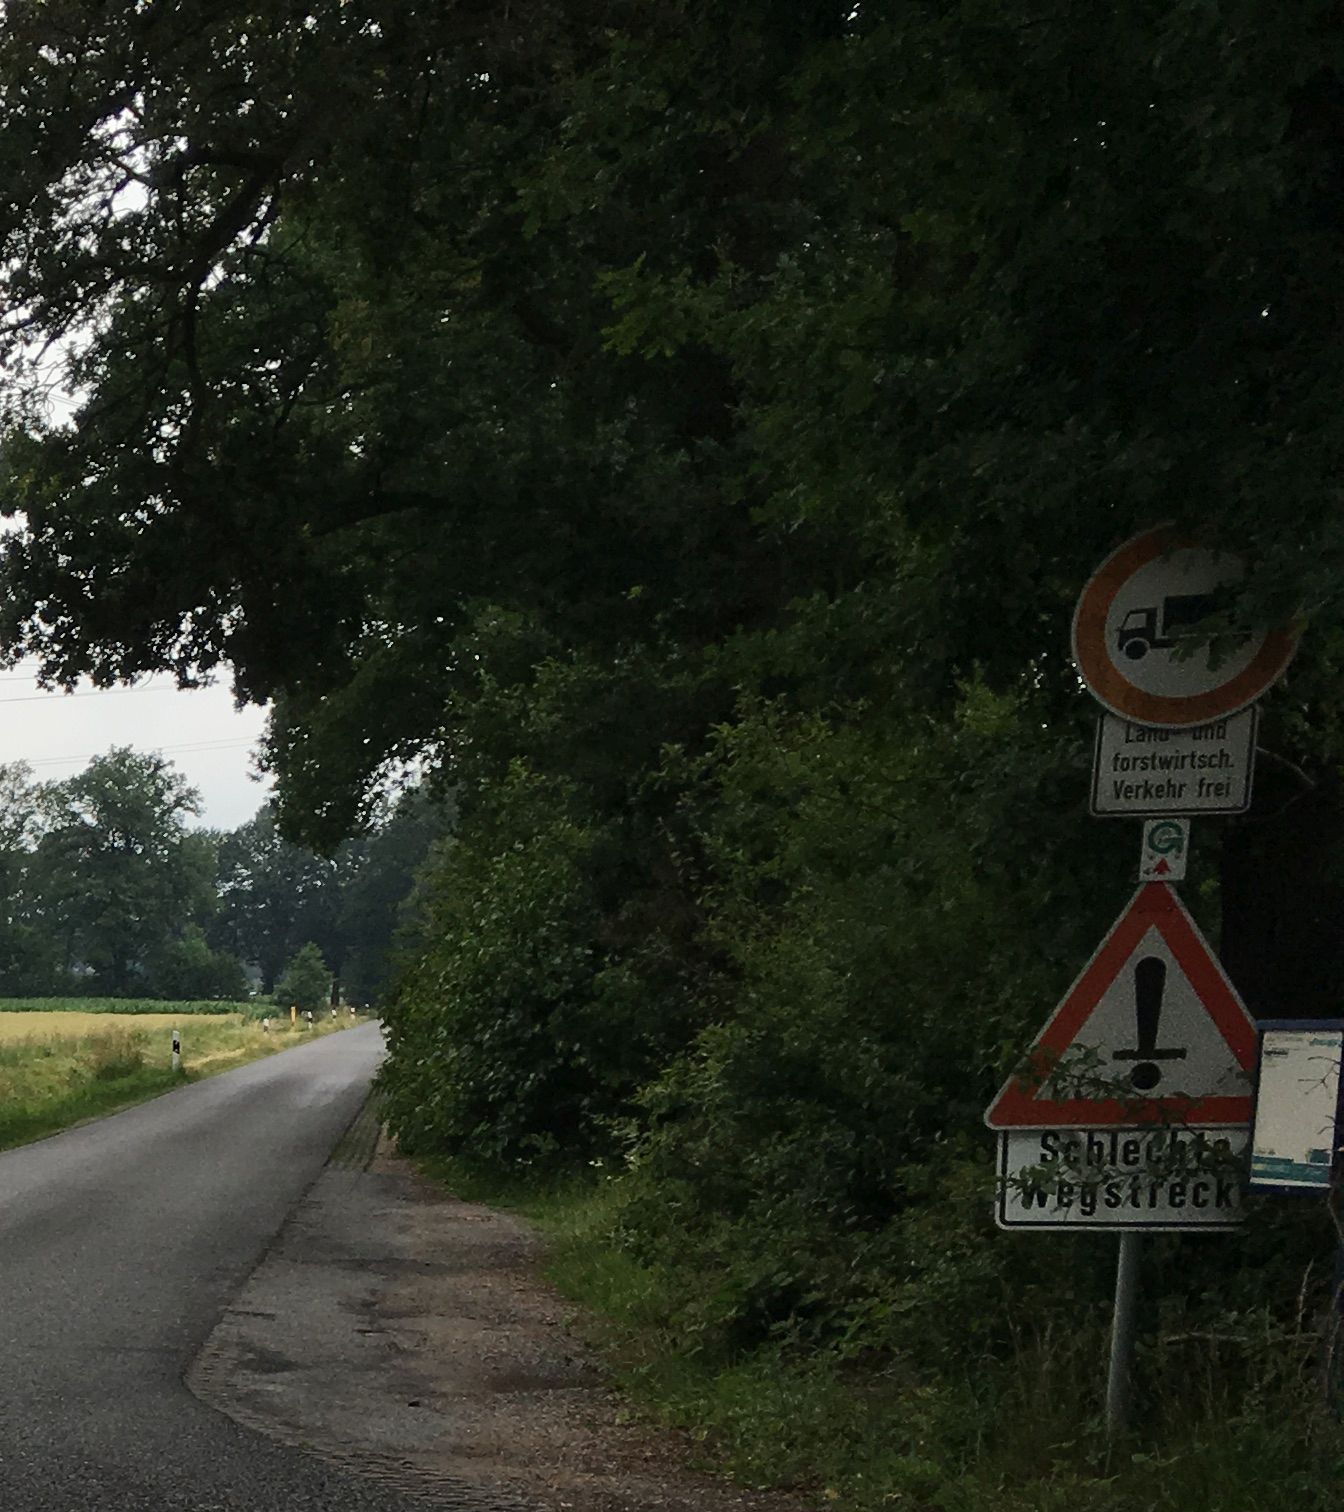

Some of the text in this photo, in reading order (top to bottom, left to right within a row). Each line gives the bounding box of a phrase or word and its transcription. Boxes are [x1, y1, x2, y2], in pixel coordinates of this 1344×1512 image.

[1112, 747, 1235, 772] forstwirtsch.
[1113, 776, 1232, 801] Verkehr frei
[1021, 1174, 1234, 1216] egstreck
